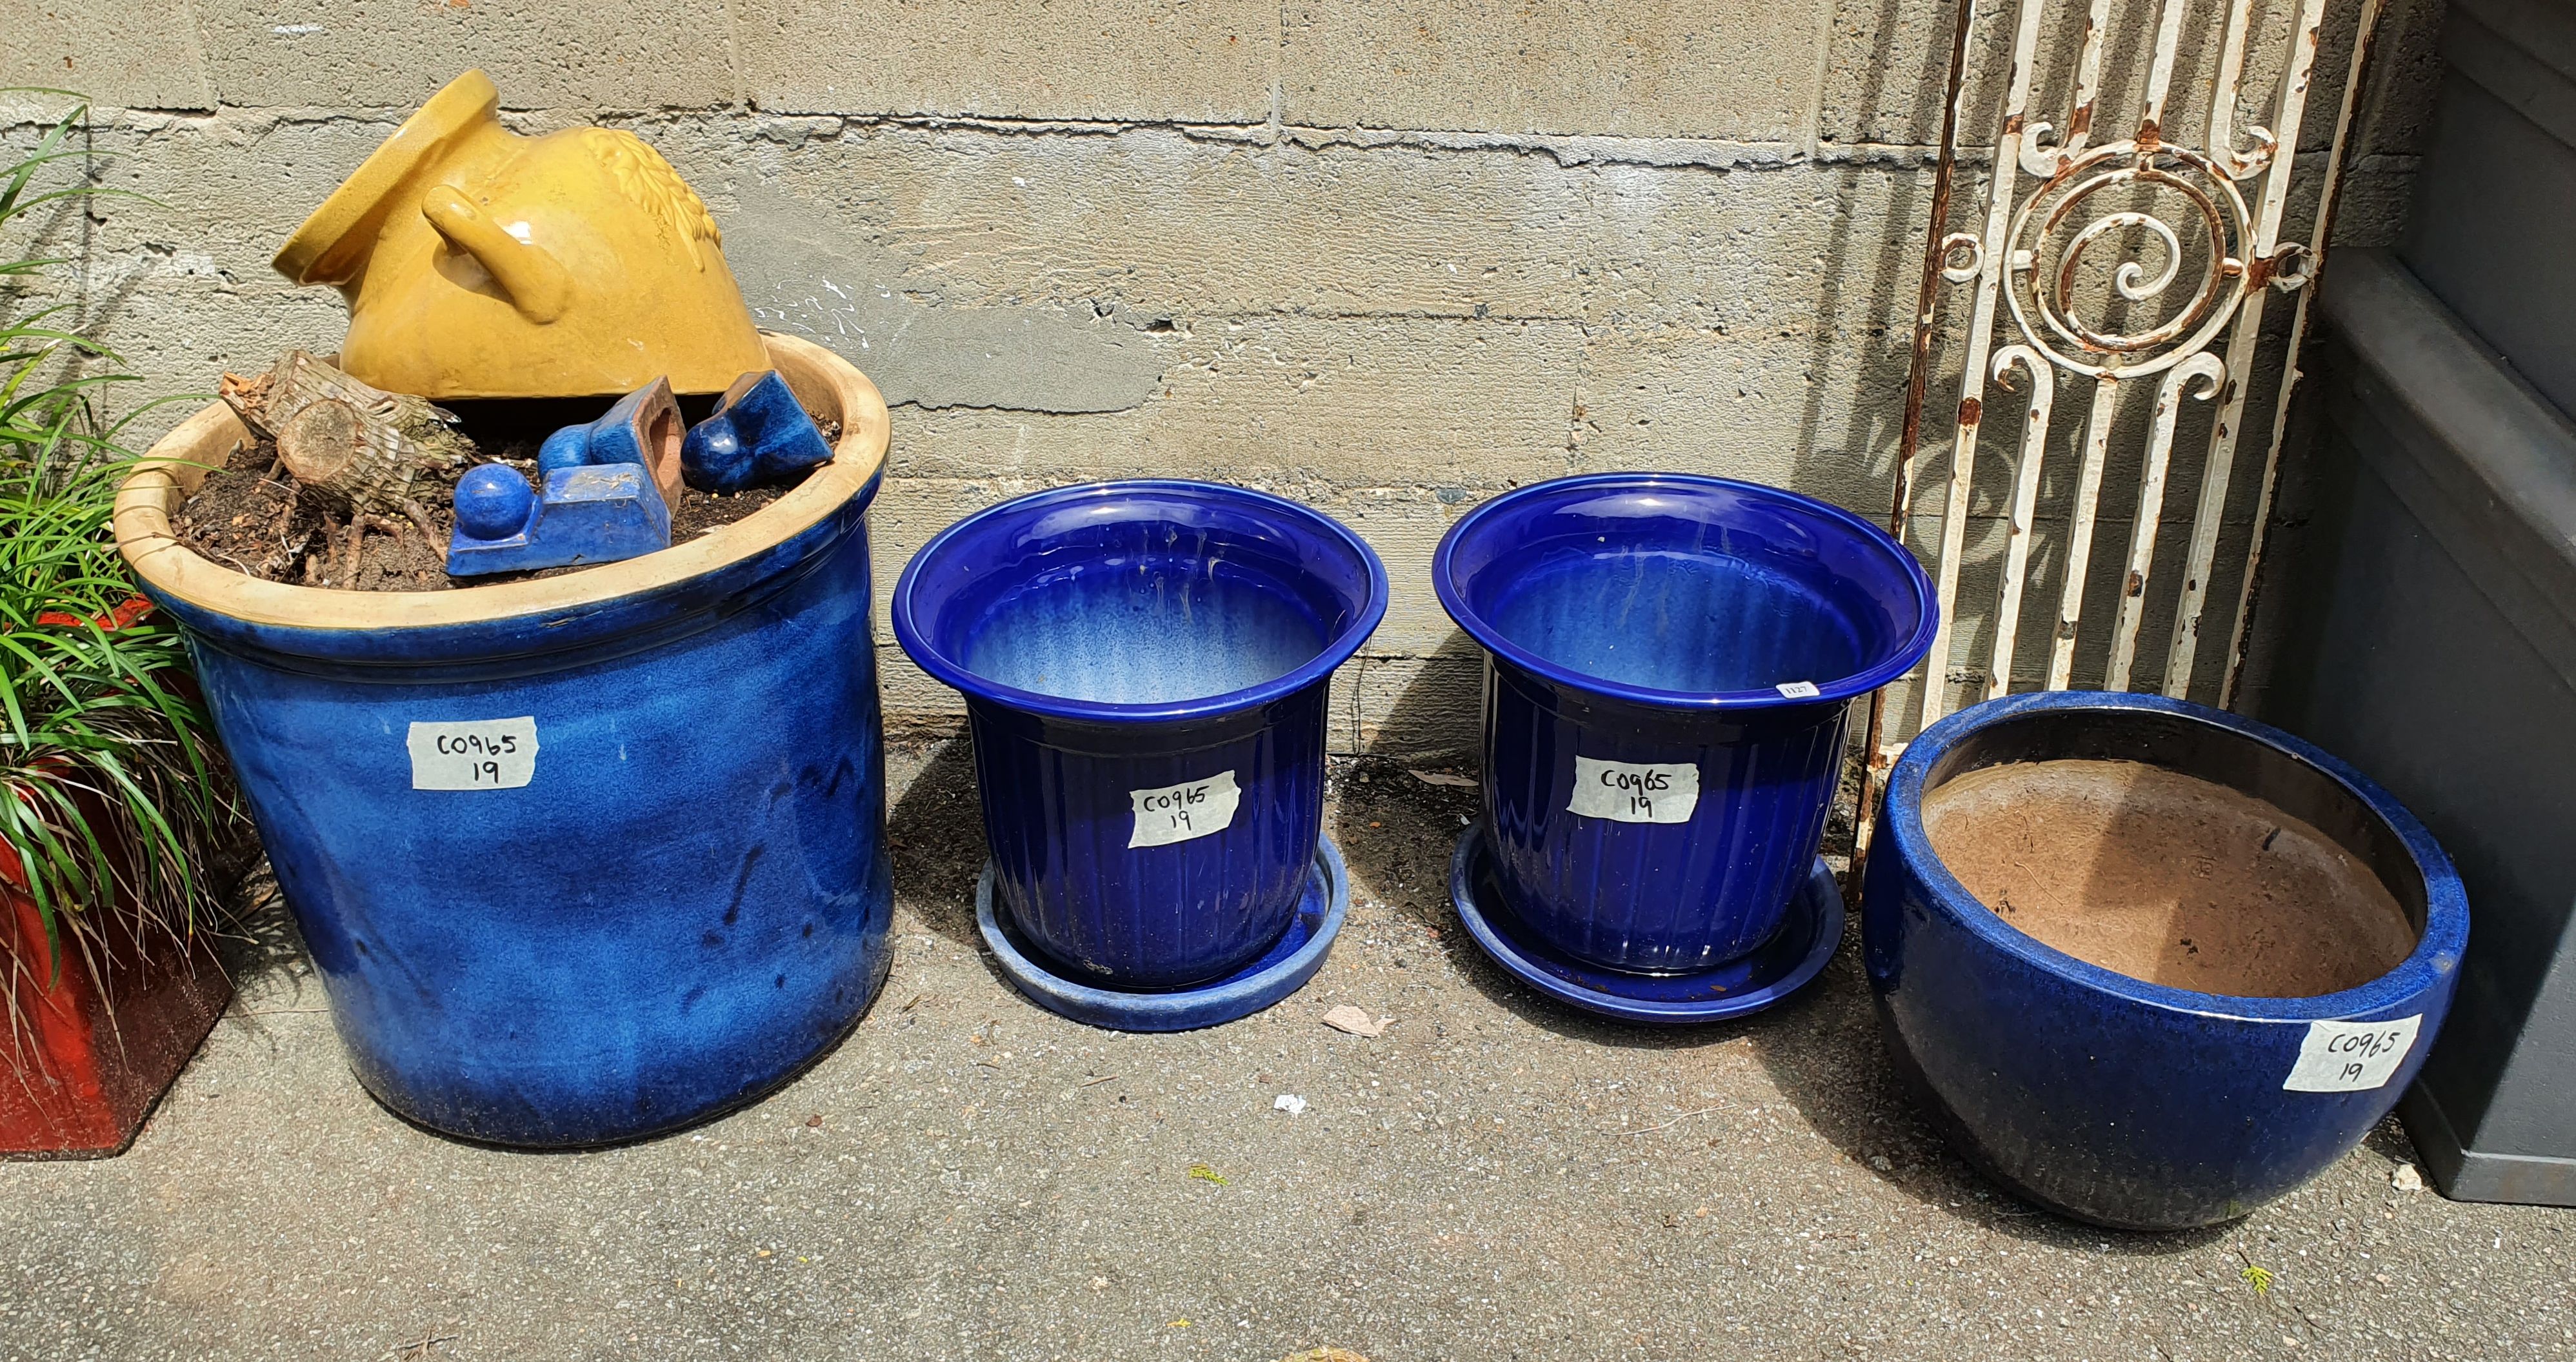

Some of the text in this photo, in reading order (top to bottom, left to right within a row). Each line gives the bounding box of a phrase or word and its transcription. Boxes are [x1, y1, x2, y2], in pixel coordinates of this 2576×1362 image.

[473, 761, 499, 784] 19
[1630, 796, 1652, 818] 19
[1170, 810, 1192, 831] 19
[2339, 1063, 2364, 1083] 19
